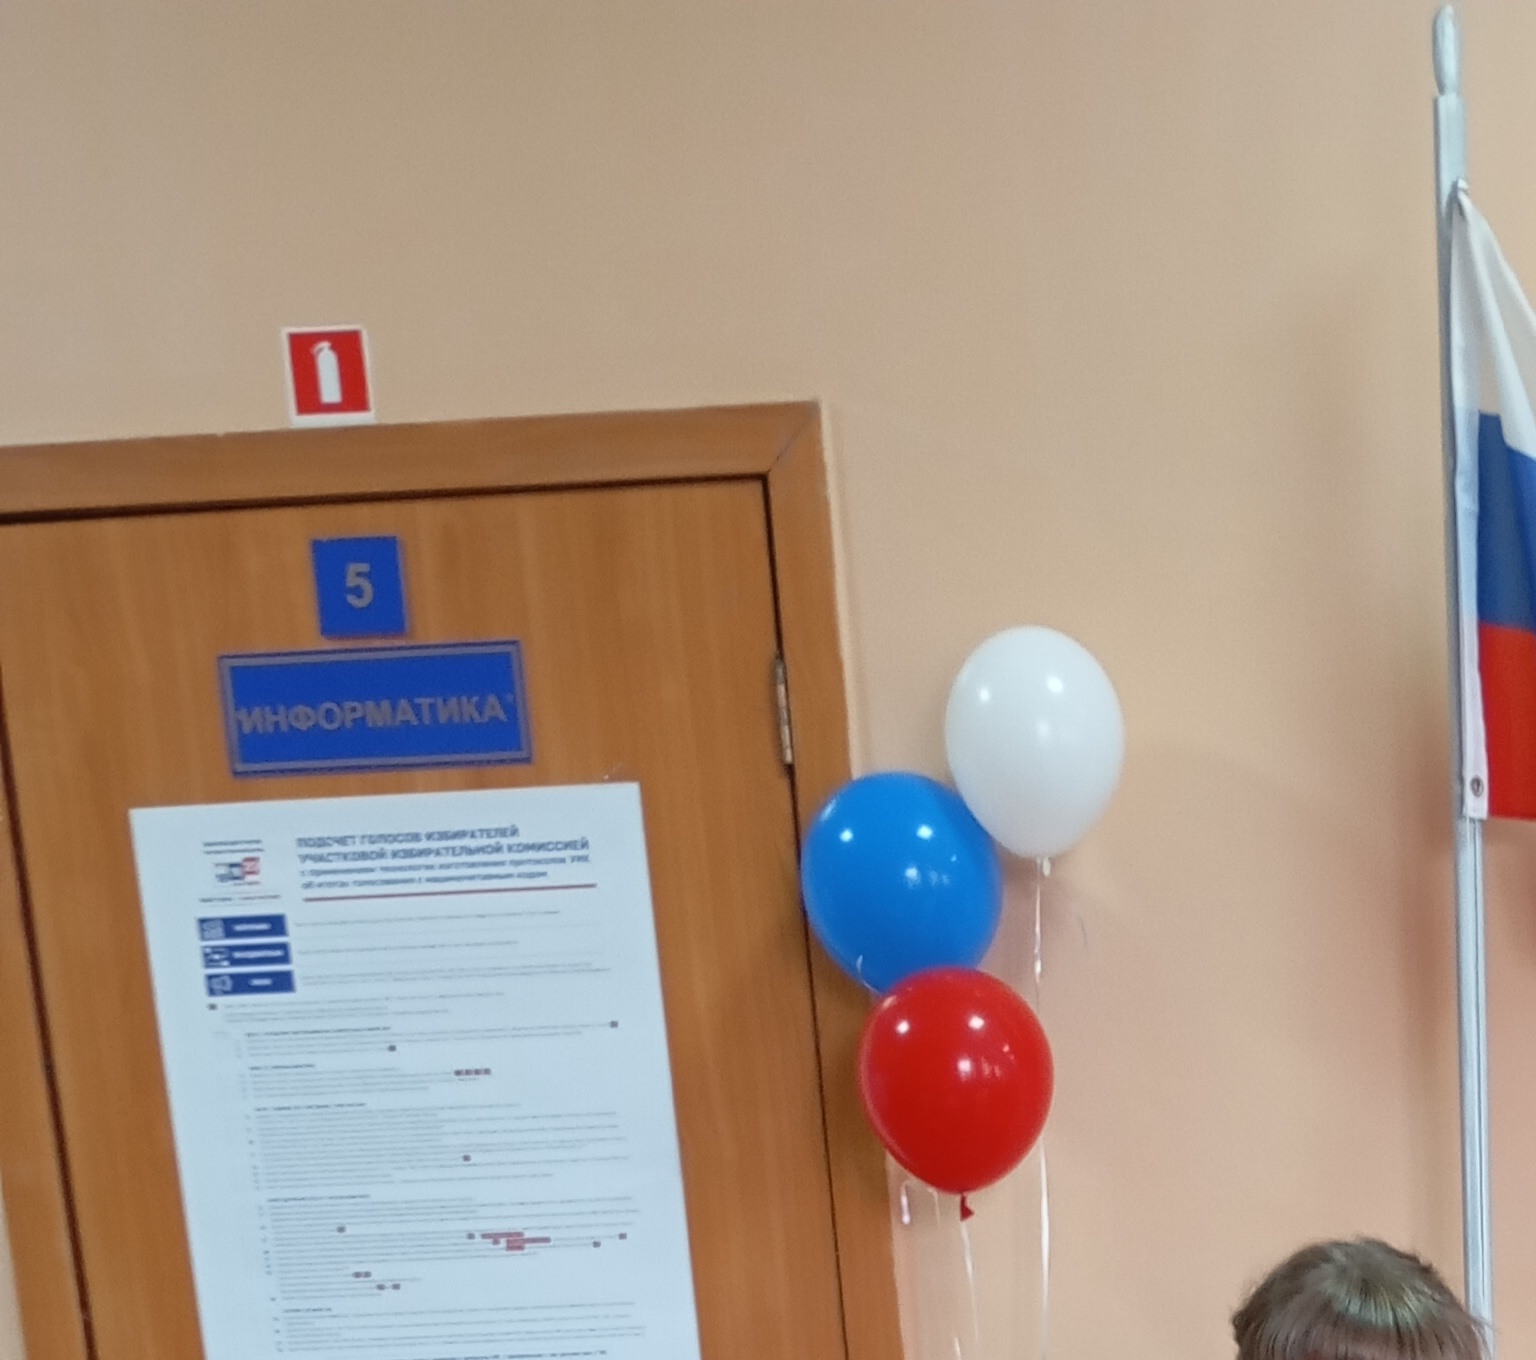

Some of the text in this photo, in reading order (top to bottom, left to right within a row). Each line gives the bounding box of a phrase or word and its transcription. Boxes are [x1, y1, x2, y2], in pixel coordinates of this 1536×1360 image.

[345, 562, 374, 609] 5
[360, 832, 422, 845] ГОЛОСОВ
[424, 824, 520, 841] ИЗБИРАТЕЛЕЙ
[297, 836, 590, 864] УЧАСТКОВОЙ ИЗБИРАТЕЛЬНОЙ КОМИССИЕЙ
